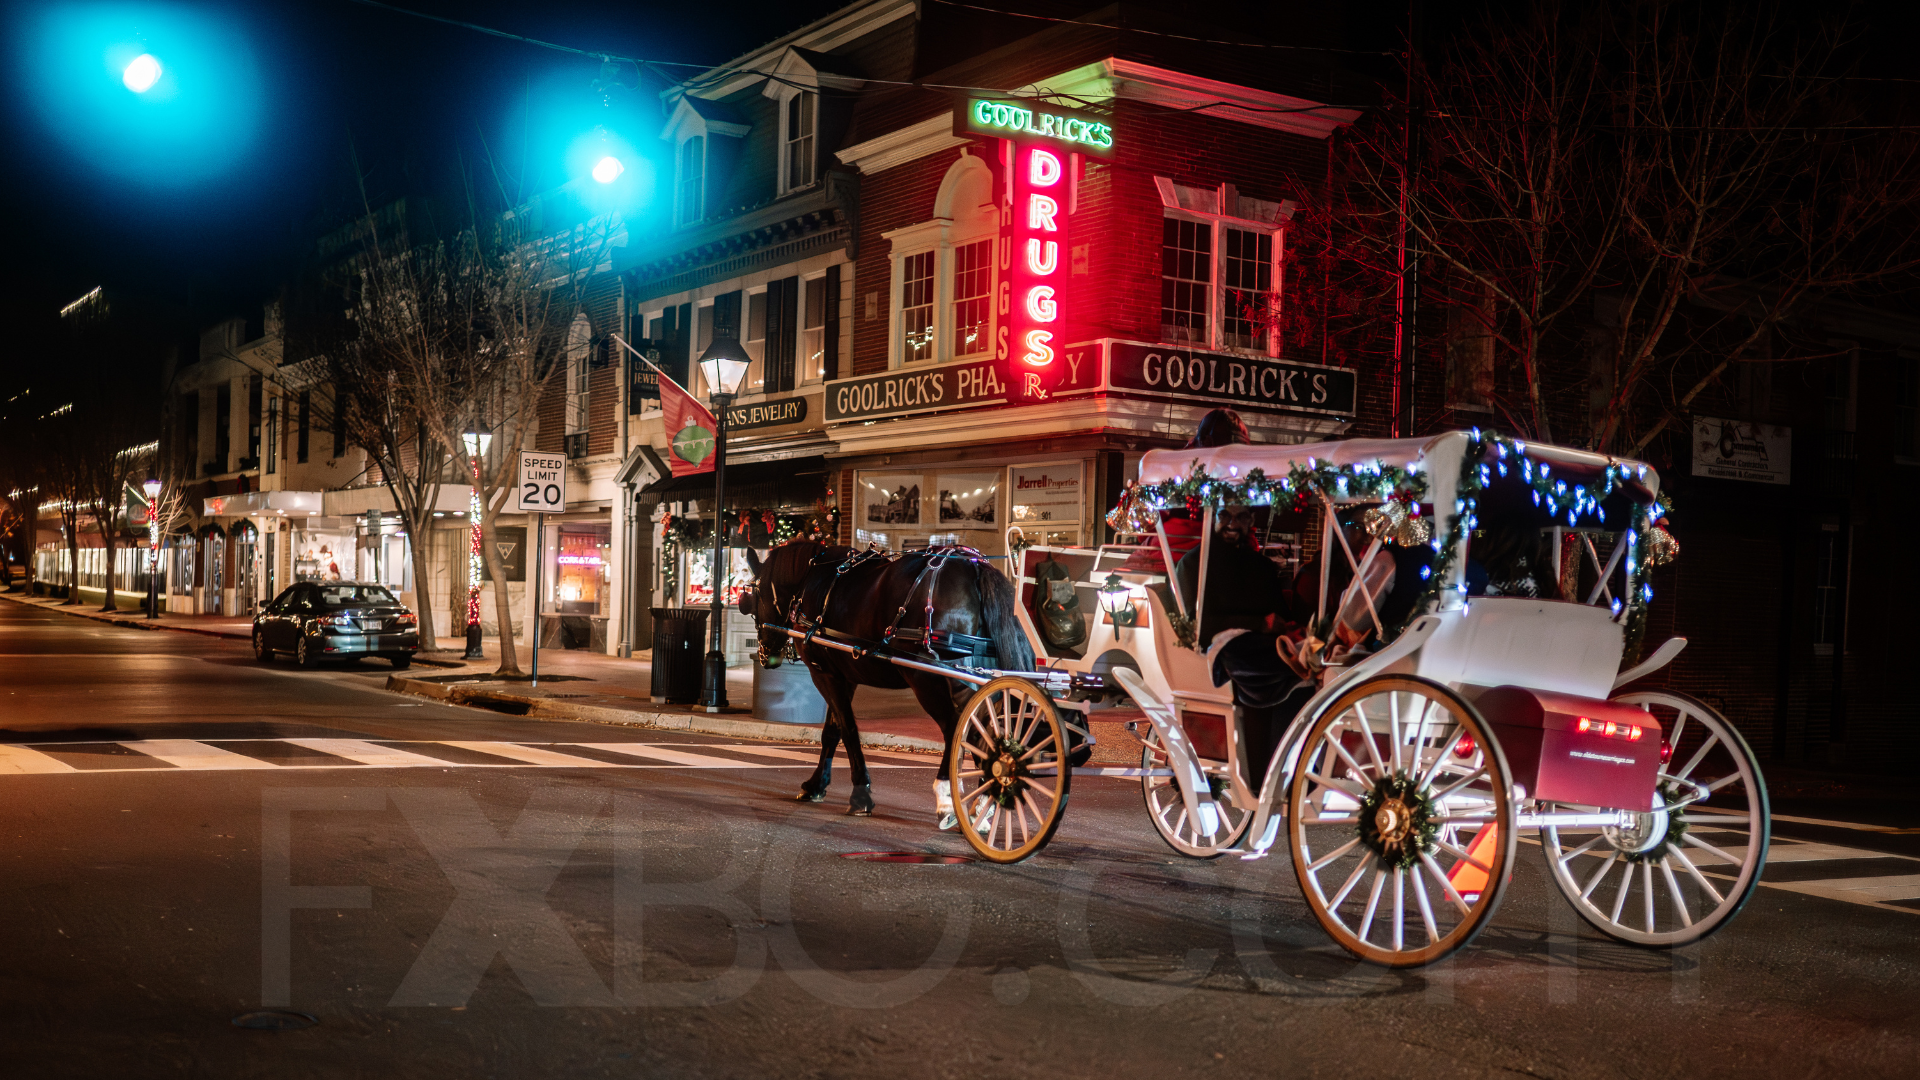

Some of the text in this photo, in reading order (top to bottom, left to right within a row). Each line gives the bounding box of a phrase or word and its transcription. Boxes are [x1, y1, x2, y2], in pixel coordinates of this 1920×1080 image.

[974, 100, 1113, 148] GOOLRICK'S
[998, 168, 1013, 361] RUGS
[1023, 149, 1061, 367] DRUGS
[1142, 353, 1328, 404] GOOLRICK'S
[837, 372, 944, 414] GOOLRICK'S
[748, 401, 801, 424] JEWELRY
[524, 458, 563, 469] SPEED
[527, 470, 558, 481] LIMIT
[522, 482, 562, 506] 20
[1047, 478, 1079, 489] Properties
[1041, 511, 1052, 520] 901
